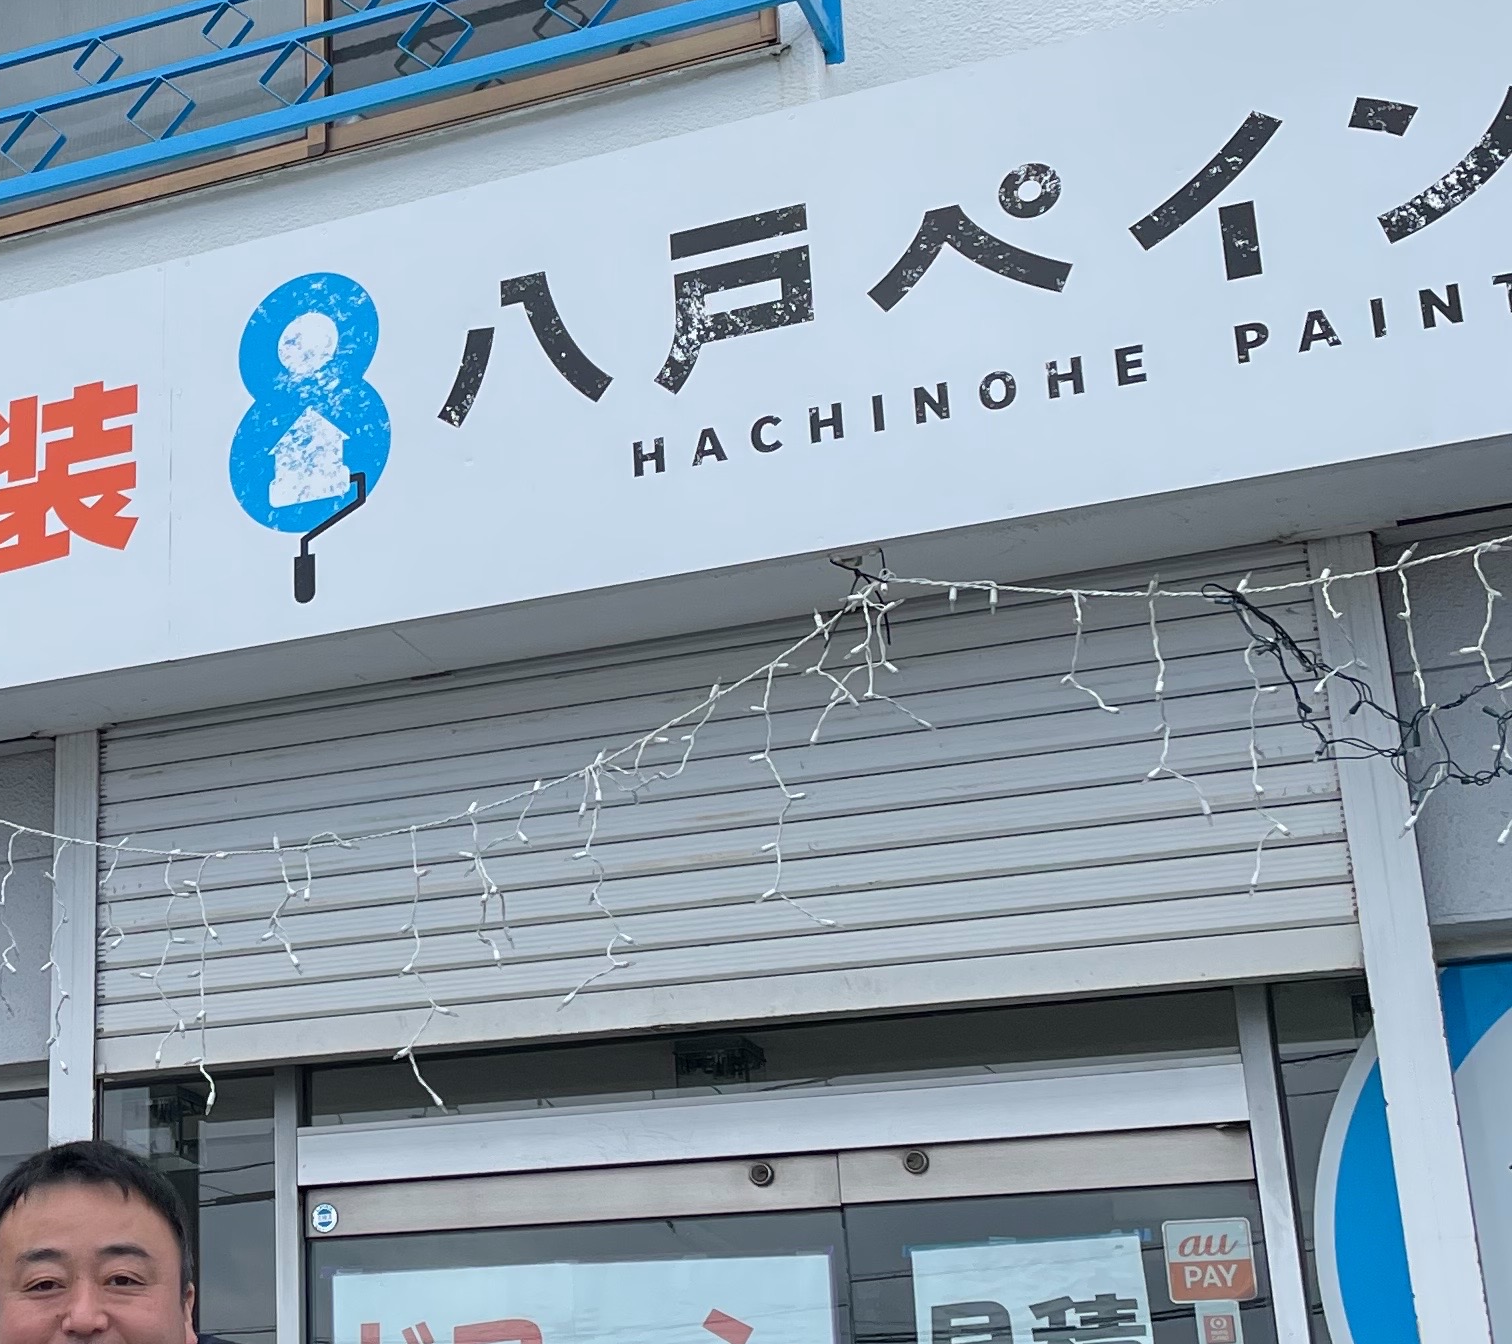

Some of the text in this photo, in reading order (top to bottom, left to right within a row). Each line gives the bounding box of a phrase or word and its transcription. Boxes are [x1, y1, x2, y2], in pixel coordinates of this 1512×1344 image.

[437, 86, 1512, 428] 八戸ペイン
[631, 342, 1150, 480] HACHINOHE
[1177, 1233, 1239, 1258] au
[1184, 1264, 1238, 1289] PAY
